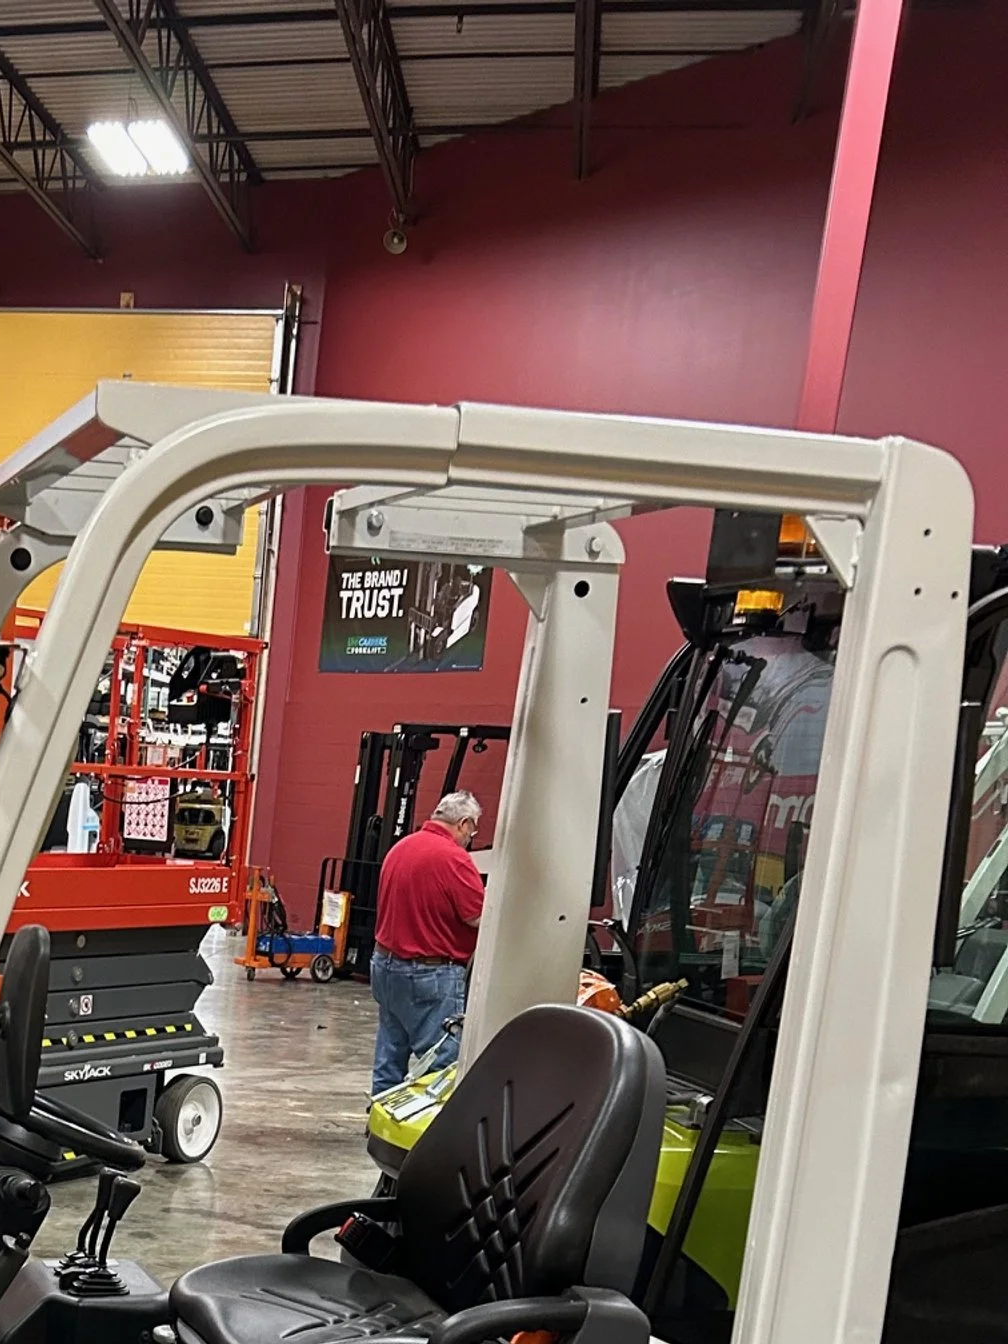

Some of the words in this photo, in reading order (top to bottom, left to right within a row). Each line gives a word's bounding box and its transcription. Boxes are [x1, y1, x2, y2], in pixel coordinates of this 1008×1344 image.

[342, 571, 362, 589] THE
[364, 569, 400, 588] BRAND
[402, 568, 408, 586] I
[339, 588, 404, 619] TRUST.
[64, 1064, 111, 1081] SKYJACK
